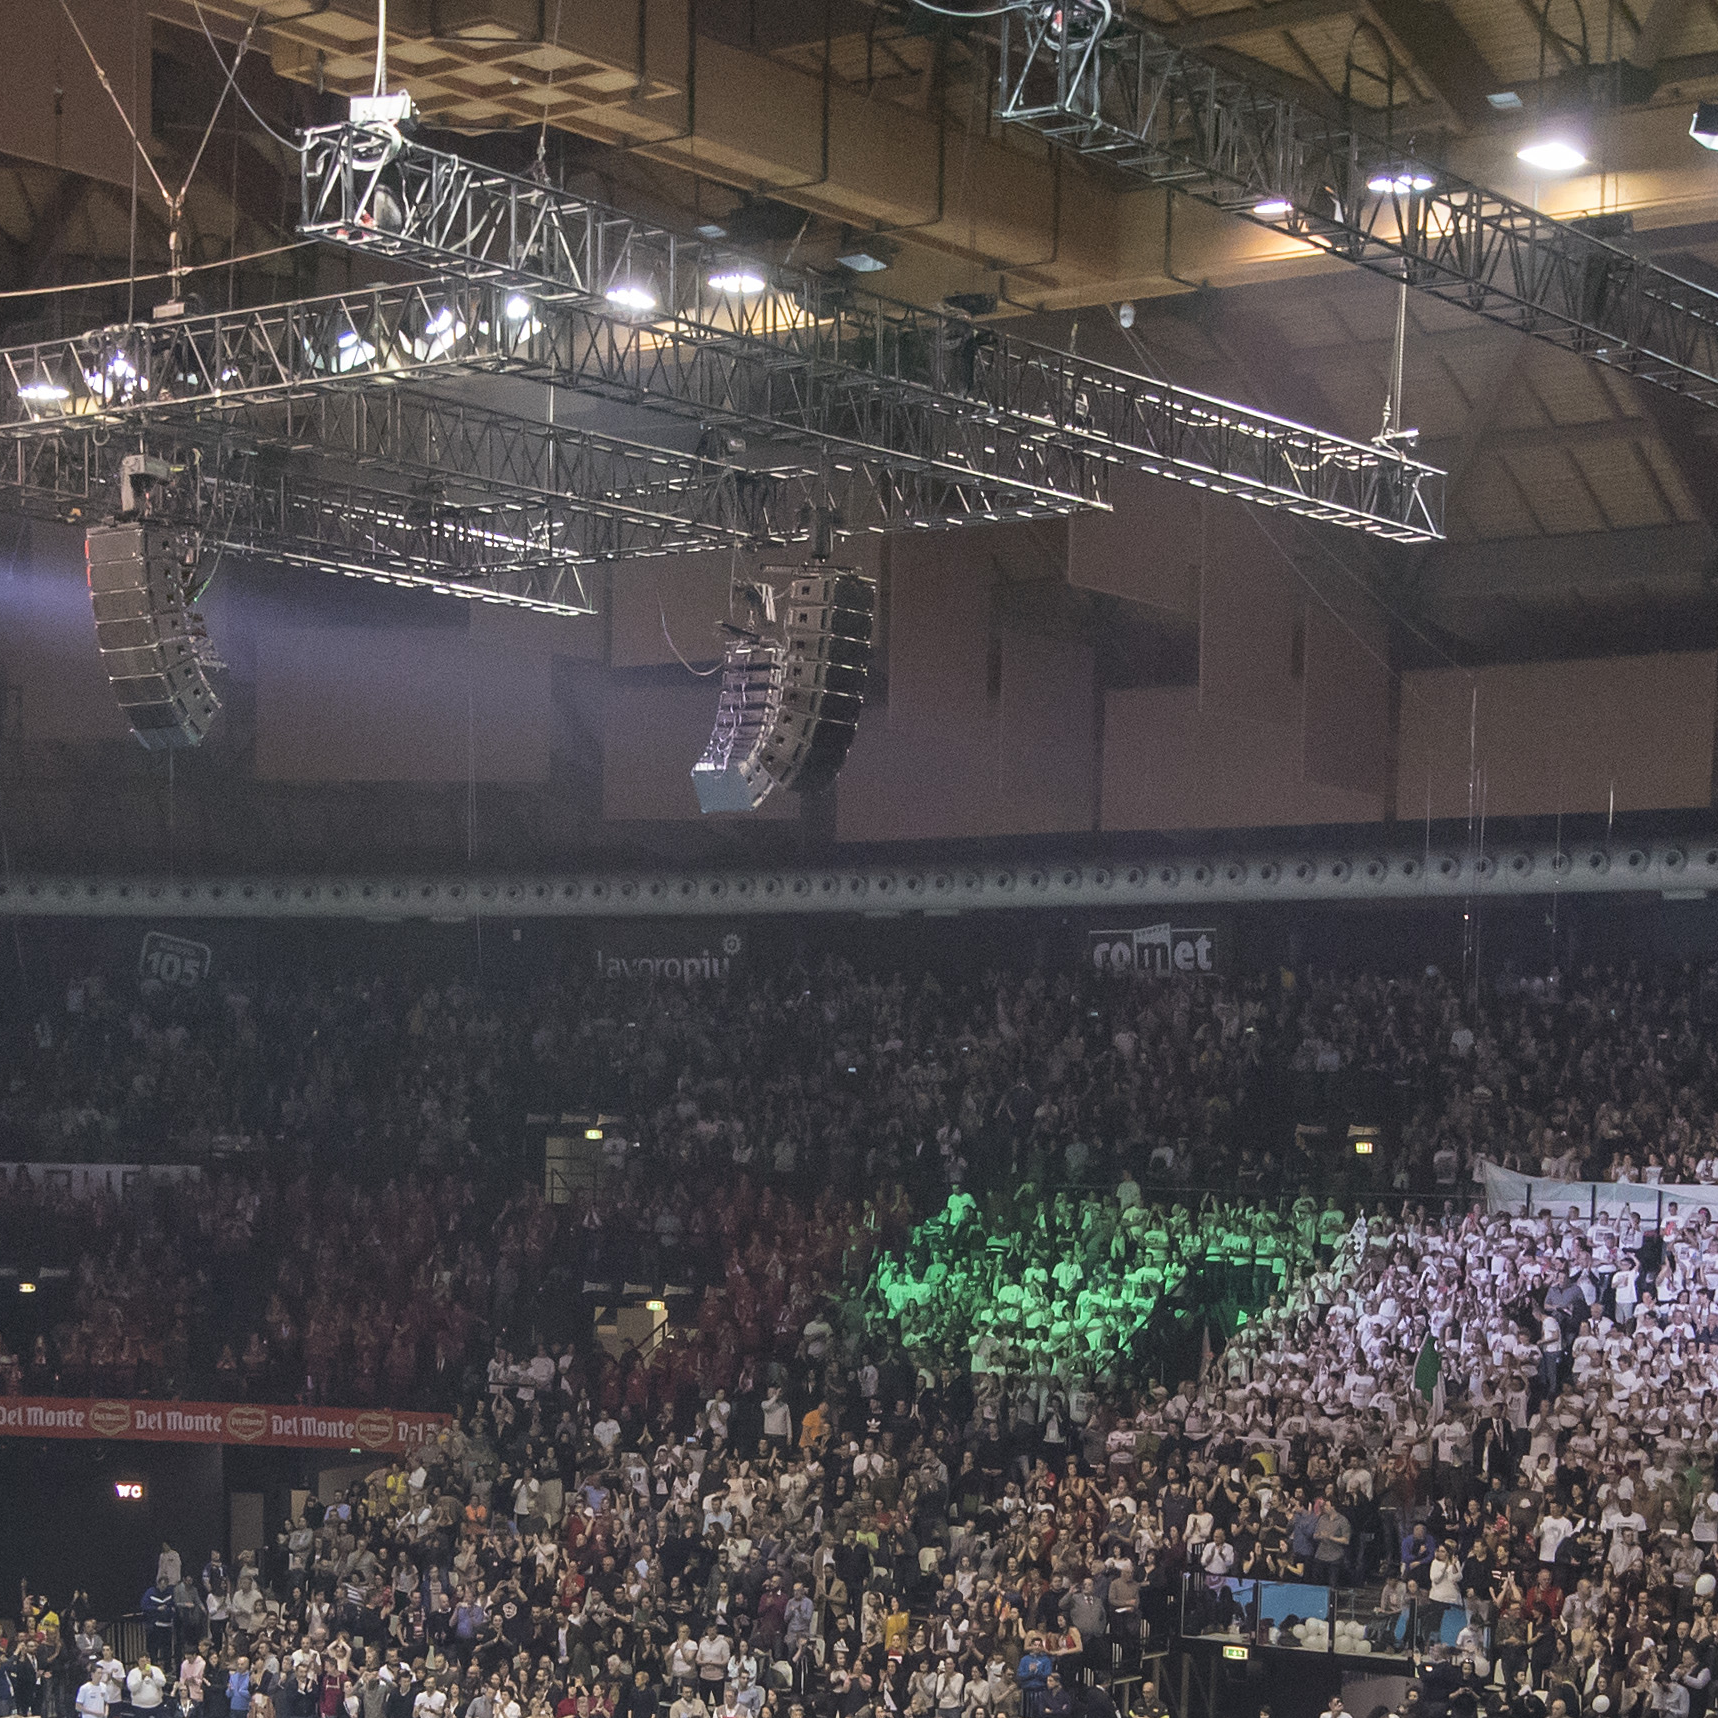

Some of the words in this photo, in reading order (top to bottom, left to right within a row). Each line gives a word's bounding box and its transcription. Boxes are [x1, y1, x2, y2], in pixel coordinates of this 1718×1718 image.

[27, 1406, 84, 1428] Monte
[135, 1410, 162, 1431] Del
[165, 1411, 222, 1433] Monte
[272, 1415, 297, 1437] Del
[301, 1417, 354, 1440] Monte
[116, 1484, 142, 1499] WC
